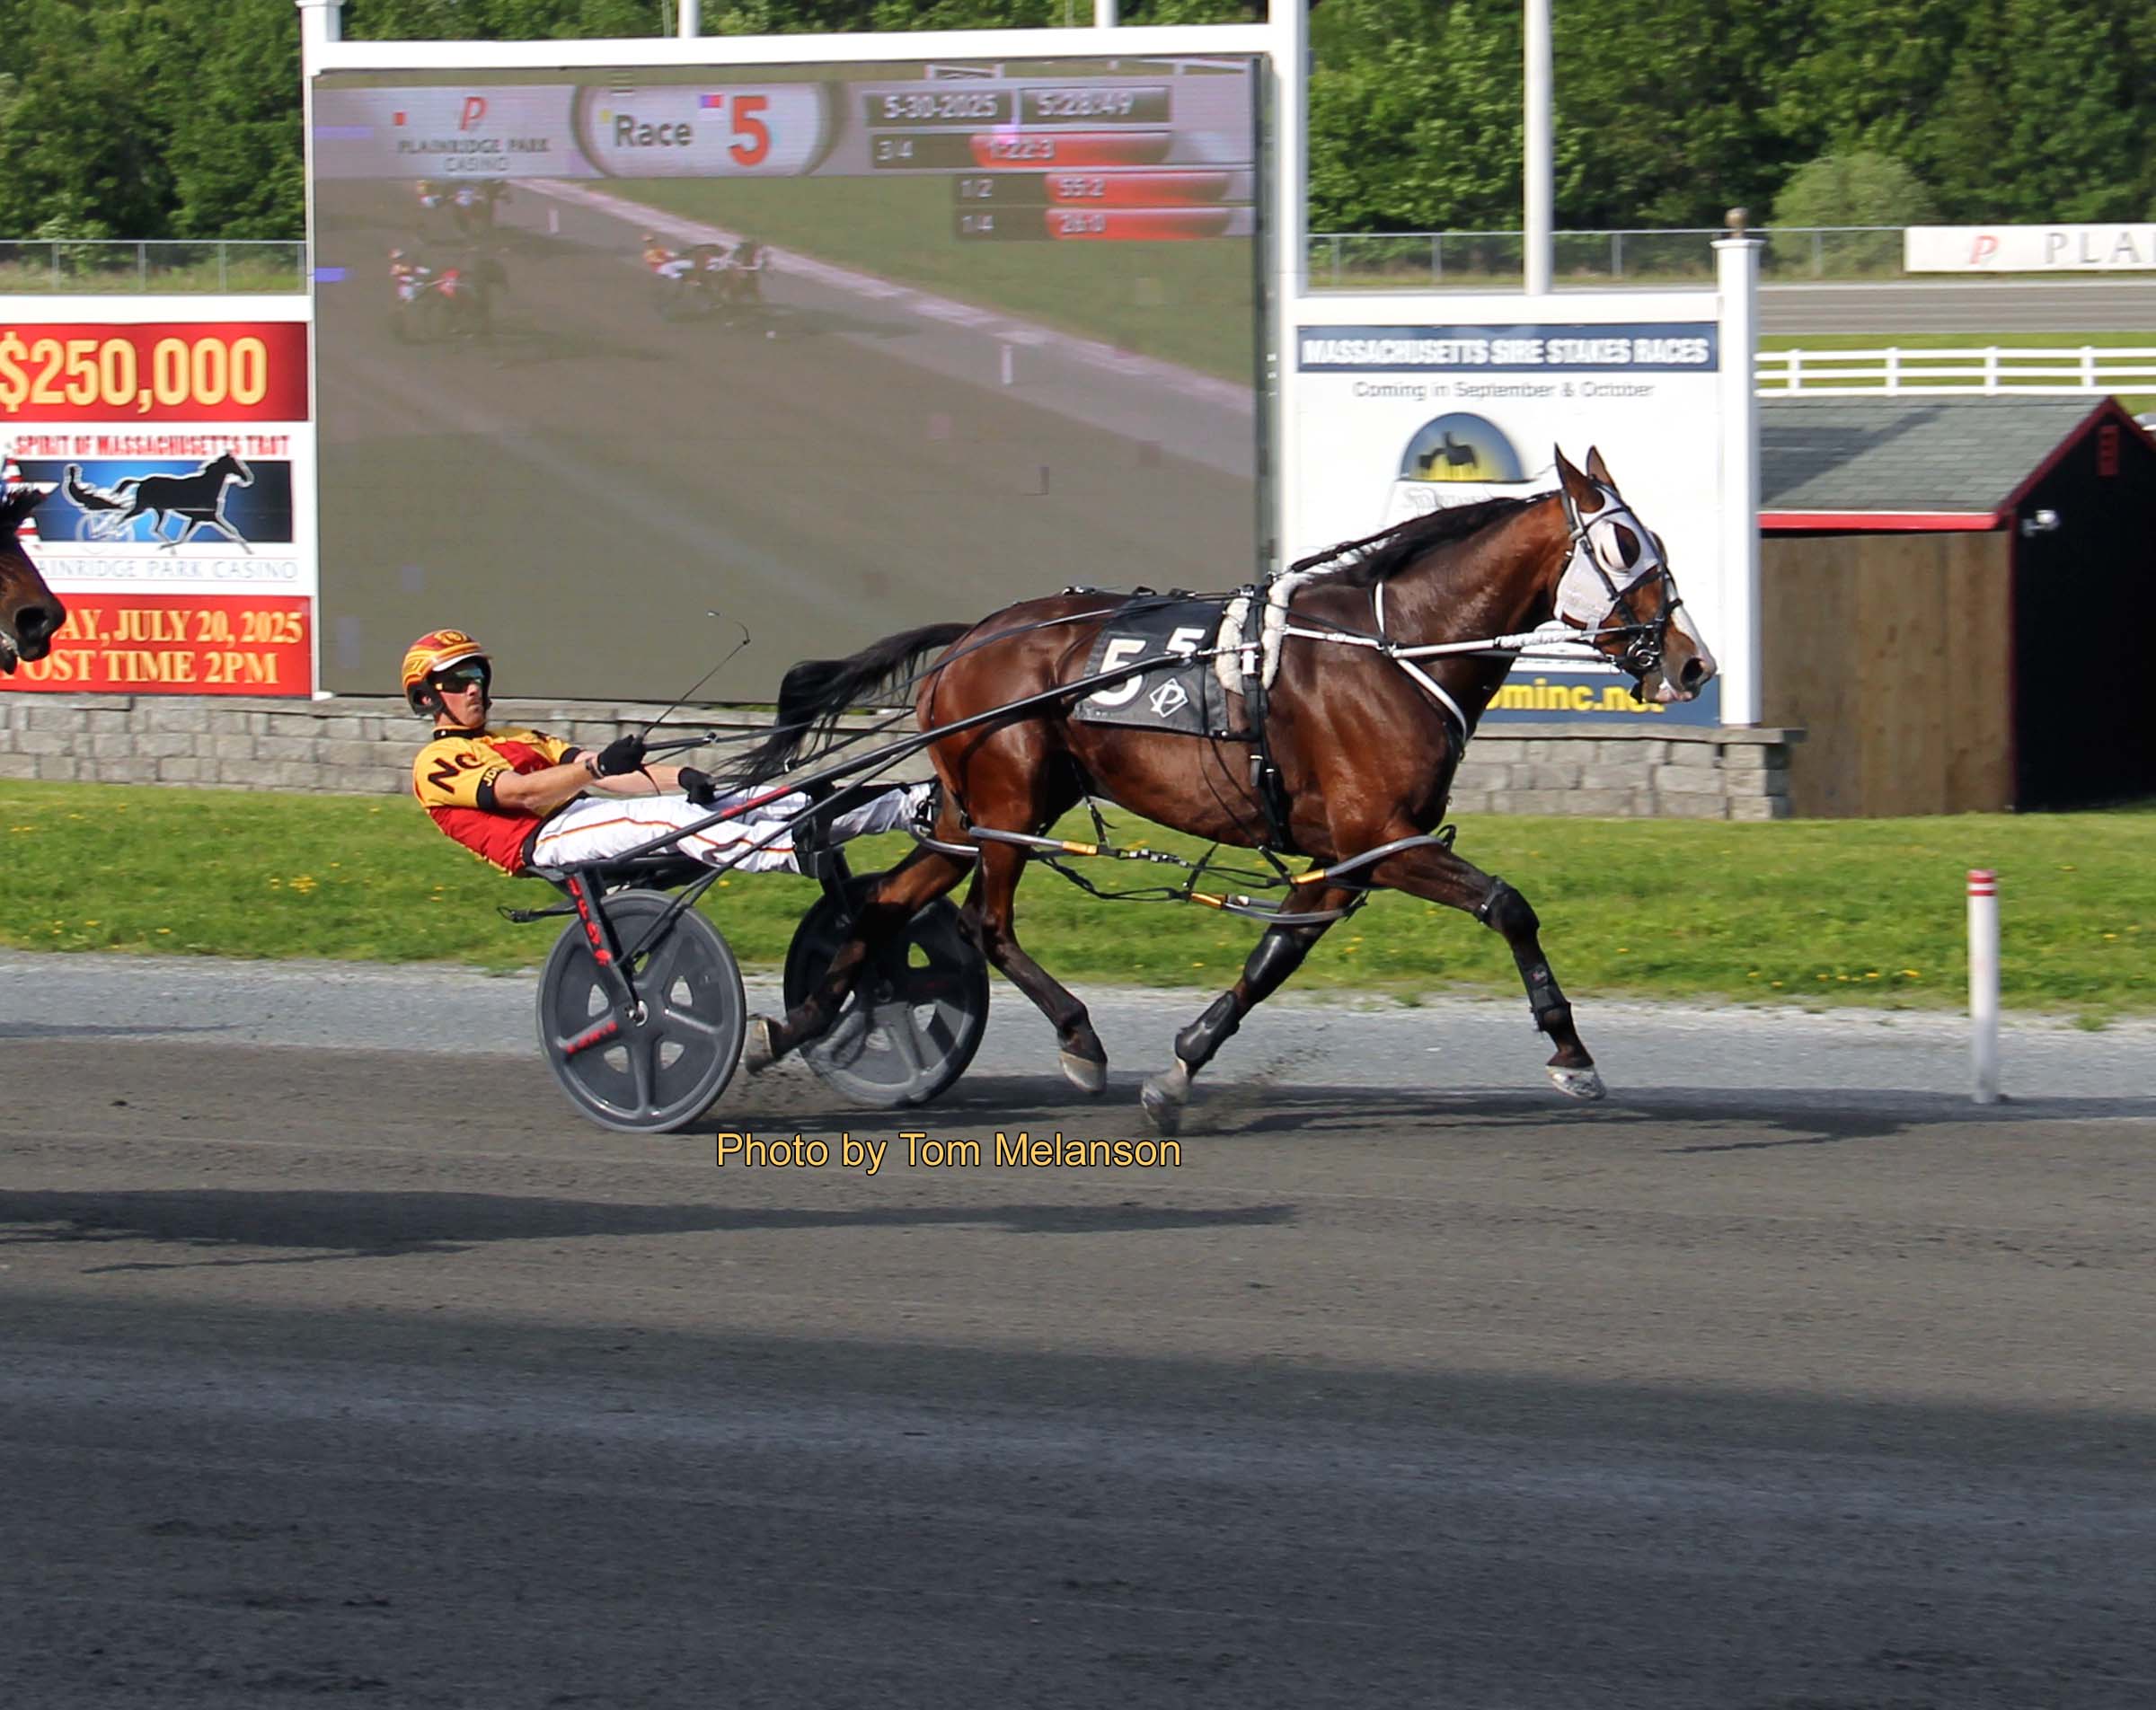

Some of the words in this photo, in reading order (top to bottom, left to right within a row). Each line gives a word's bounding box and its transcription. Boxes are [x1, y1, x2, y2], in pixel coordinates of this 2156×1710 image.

[883, 94, 998, 119] 5-30-2025
[614, 116, 692, 146] Race
[729, 95, 770, 166] 5
[398, 138, 500, 154] PLAINRIDGE
[508, 137, 551, 153] PARK
[446, 156, 511, 172] CASINO
[1303, 339, 1489, 364] MASSACHUSETTS
[1490, 339, 1544, 364] SIRE
[1545, 339, 1631, 364] STAKES
[1632, 339, 1709, 363] RACES
[0, 331, 267, 413] $250,000
[1353, 382, 1427, 401] Coming
[1434, 383, 1449, 397] in
[1454, 382, 1556, 401] September
[1560, 383, 1574, 397] &
[1579, 381, 1656, 397] October
[36, 560, 136, 577] AINRIDGE
[147, 560, 202, 577] PARK
[214, 560, 298, 579] CASINO
[51, 609, 109, 647] AY,
[113, 609, 191, 642] JULY
[197, 610, 235, 648] 20,
[240, 612, 303, 644] 2025
[102, 650, 197, 683] TIME
[204, 651, 279, 684] 2PM
[1090, 639, 1146, 706] 5
